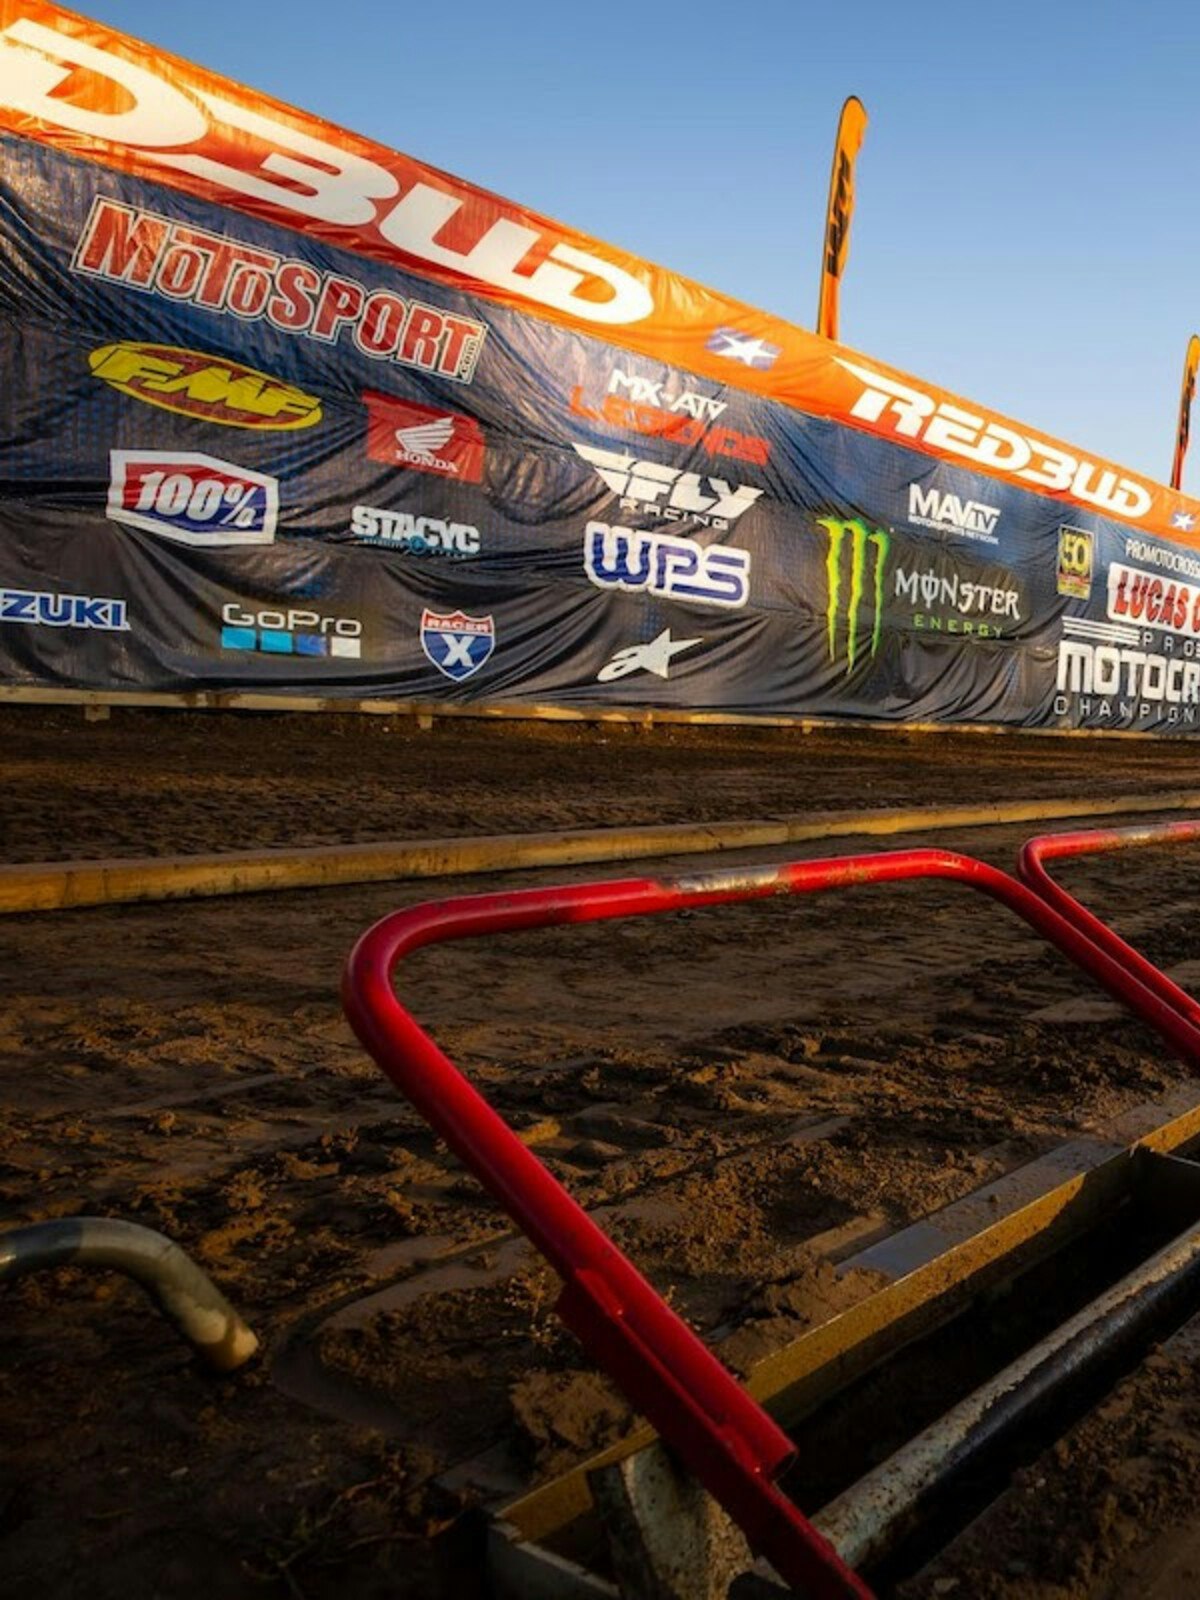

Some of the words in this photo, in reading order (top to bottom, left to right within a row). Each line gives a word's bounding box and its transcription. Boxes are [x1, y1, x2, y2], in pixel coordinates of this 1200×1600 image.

[91, 346, 322, 418] FMF
[832, 356, 1152, 518] REDBUD
[396, 449, 459, 473] HONDA
[571, 443, 765, 519] FLY
[138, 471, 259, 528] 100%
[619, 497, 729, 530] RACING
[351, 505, 480, 553] STACYC
[584, 520, 751, 608] WPS
[0, 588, 131, 630] ZUKI
[896, 567, 1020, 620] MONSTER
[1114, 571, 1189, 630] LUCAS
[222, 604, 361, 636] GoPro
[426, 617, 490, 633] RACER
[914, 613, 1003, 638] ENERGY
[441, 633, 475, 668] X
[1142, 632, 1196, 657] PRO
